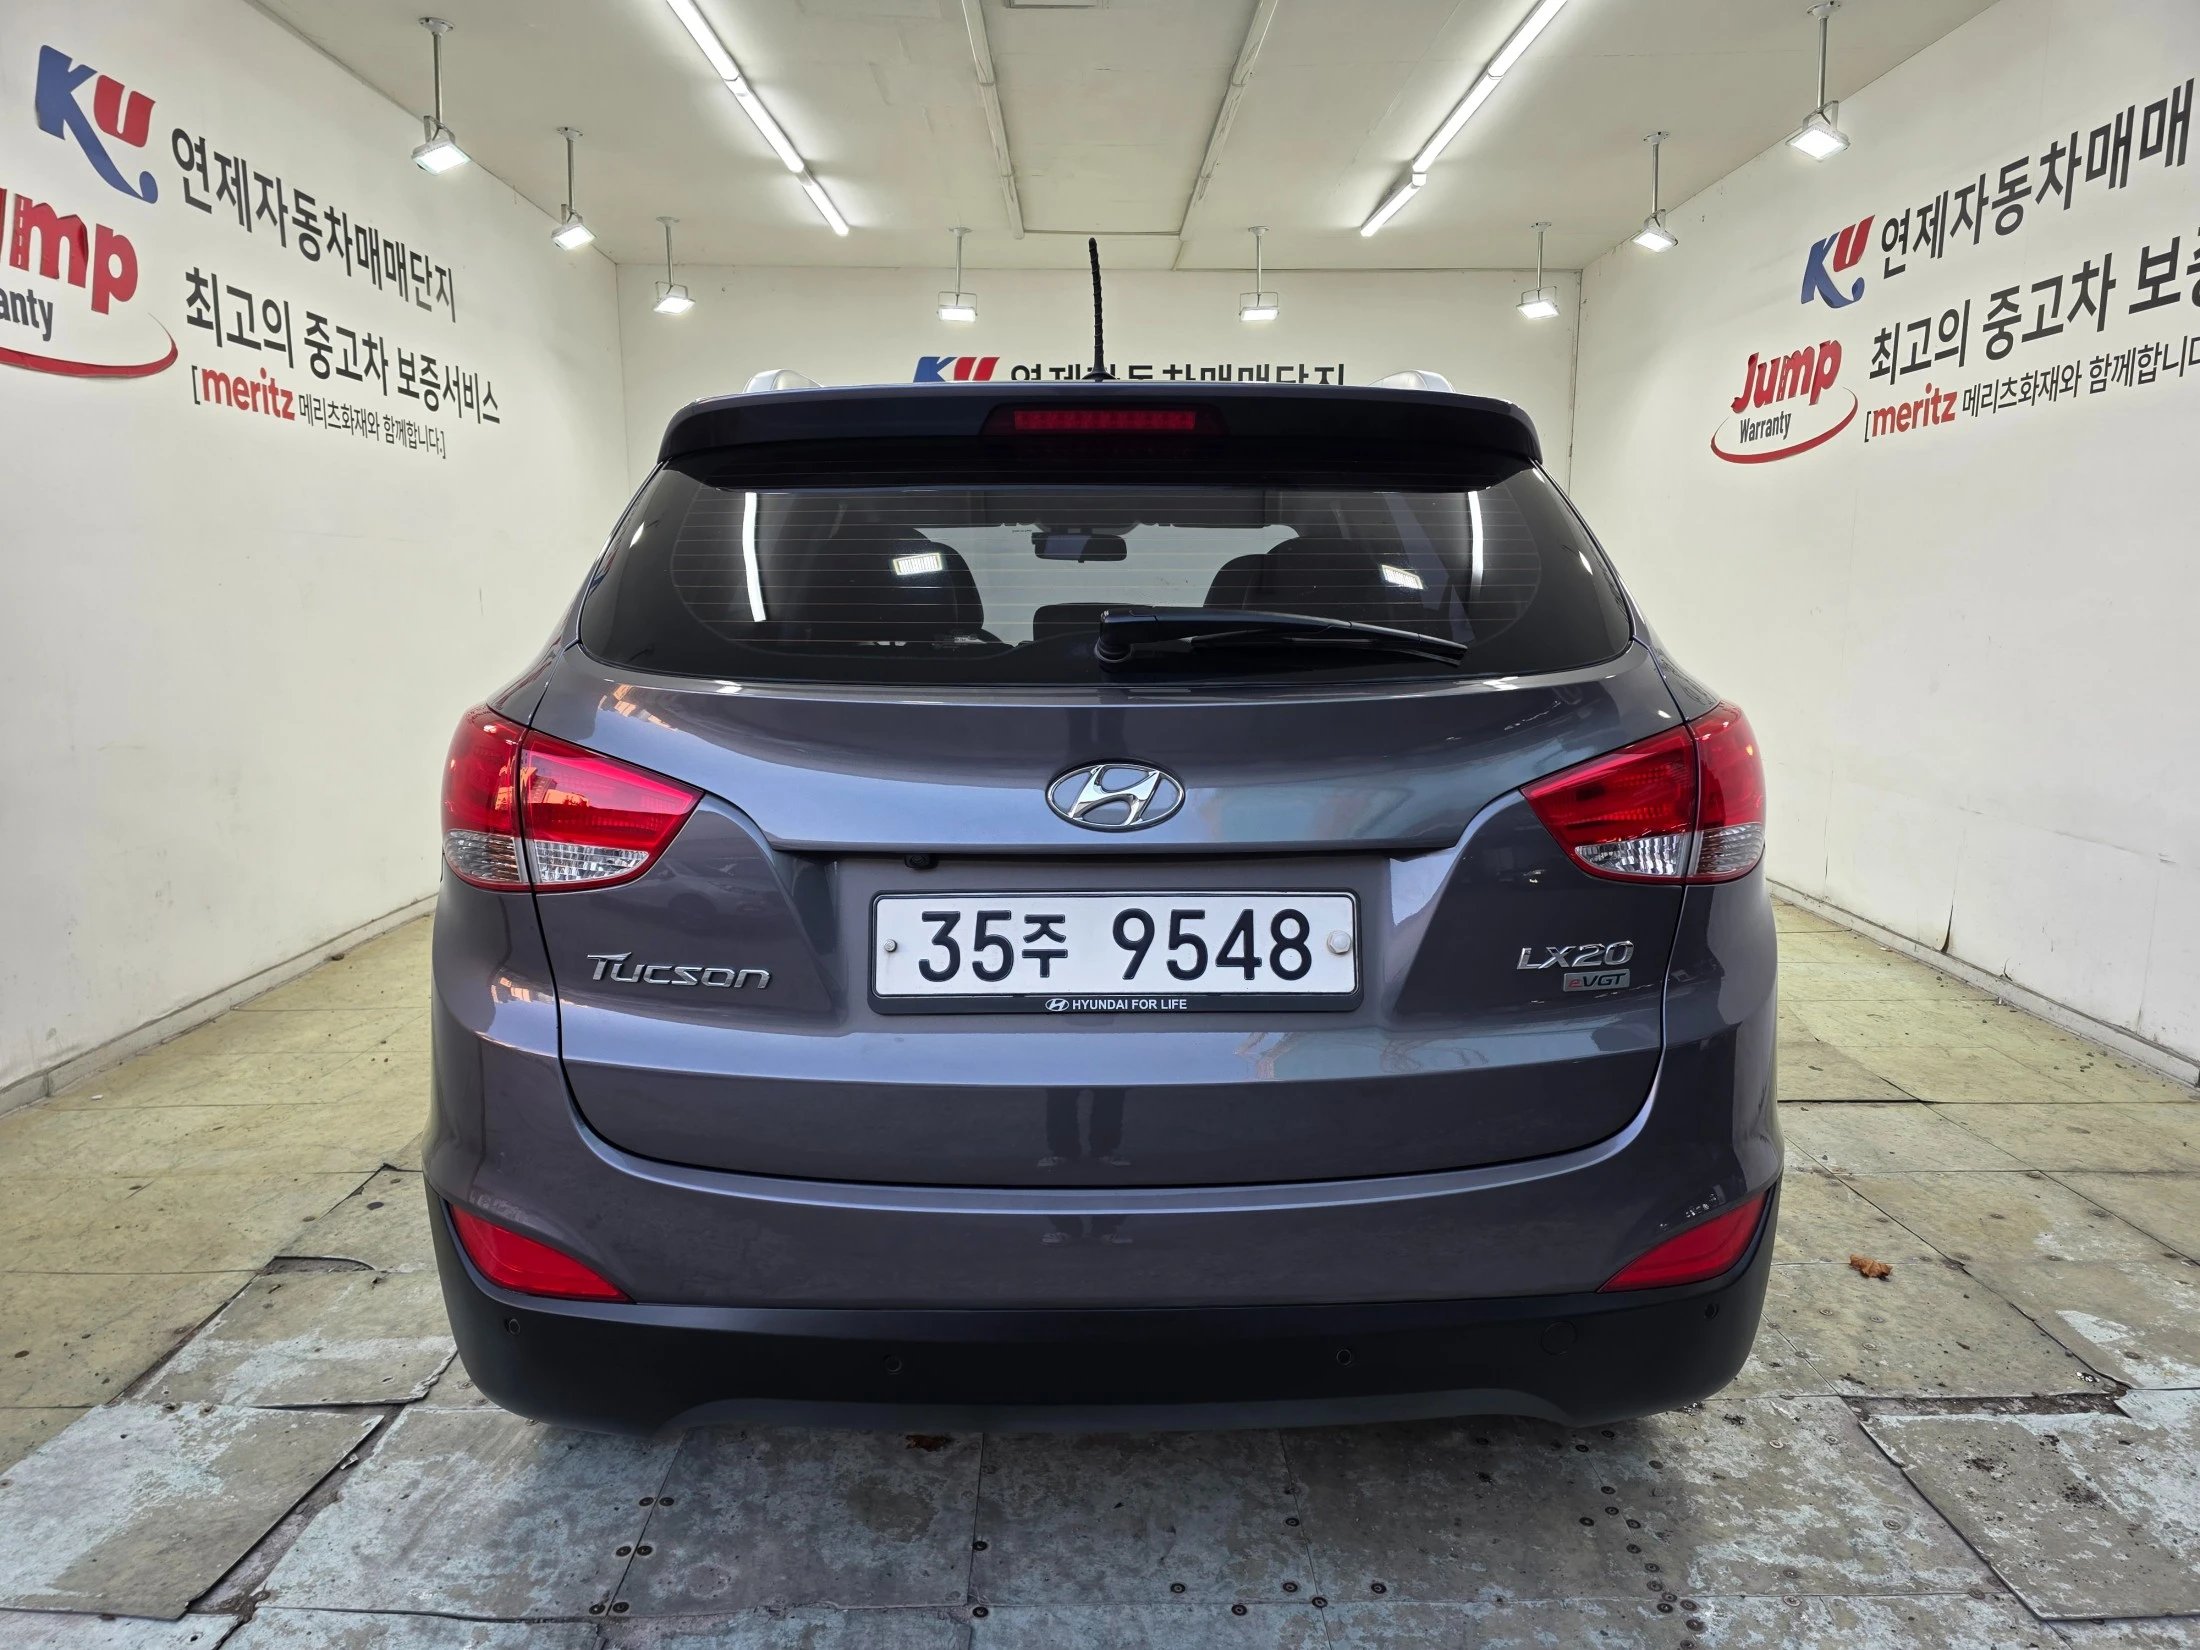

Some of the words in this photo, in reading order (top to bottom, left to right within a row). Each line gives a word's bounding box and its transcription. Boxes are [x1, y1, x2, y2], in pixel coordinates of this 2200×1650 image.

[1881, 78, 2195, 280] 연제자동차매매
[0, 187, 138, 315] mp
[171, 128, 456, 323] 연제자동차매매단지
[185, 267, 295, 368] 최고의
[304, 311, 389, 395] 중고차
[397, 347, 500, 424] 보증서비스
[1869, 299, 1971, 385] 최고의
[1983, 252, 2117, 361] 중고차
[1731, 339, 1842, 413] Jump
[1962, 360, 2082, 417] 메리츠화재와
[298, 394, 380, 441] 메리츠화재와
[1739, 410, 1791, 443] Warranty
[918, 908, 1068, 982] 35주
[1112, 908, 1313, 982] 9548
[1516, 940, 1634, 970] LX20
[1568, 972, 1627, 988] eVGT
[1072, 999, 1128, 1010] HYUNDAI
[1131, 999, 1157, 1010] FOR
[1161, 999, 1187, 1010] LIFE
